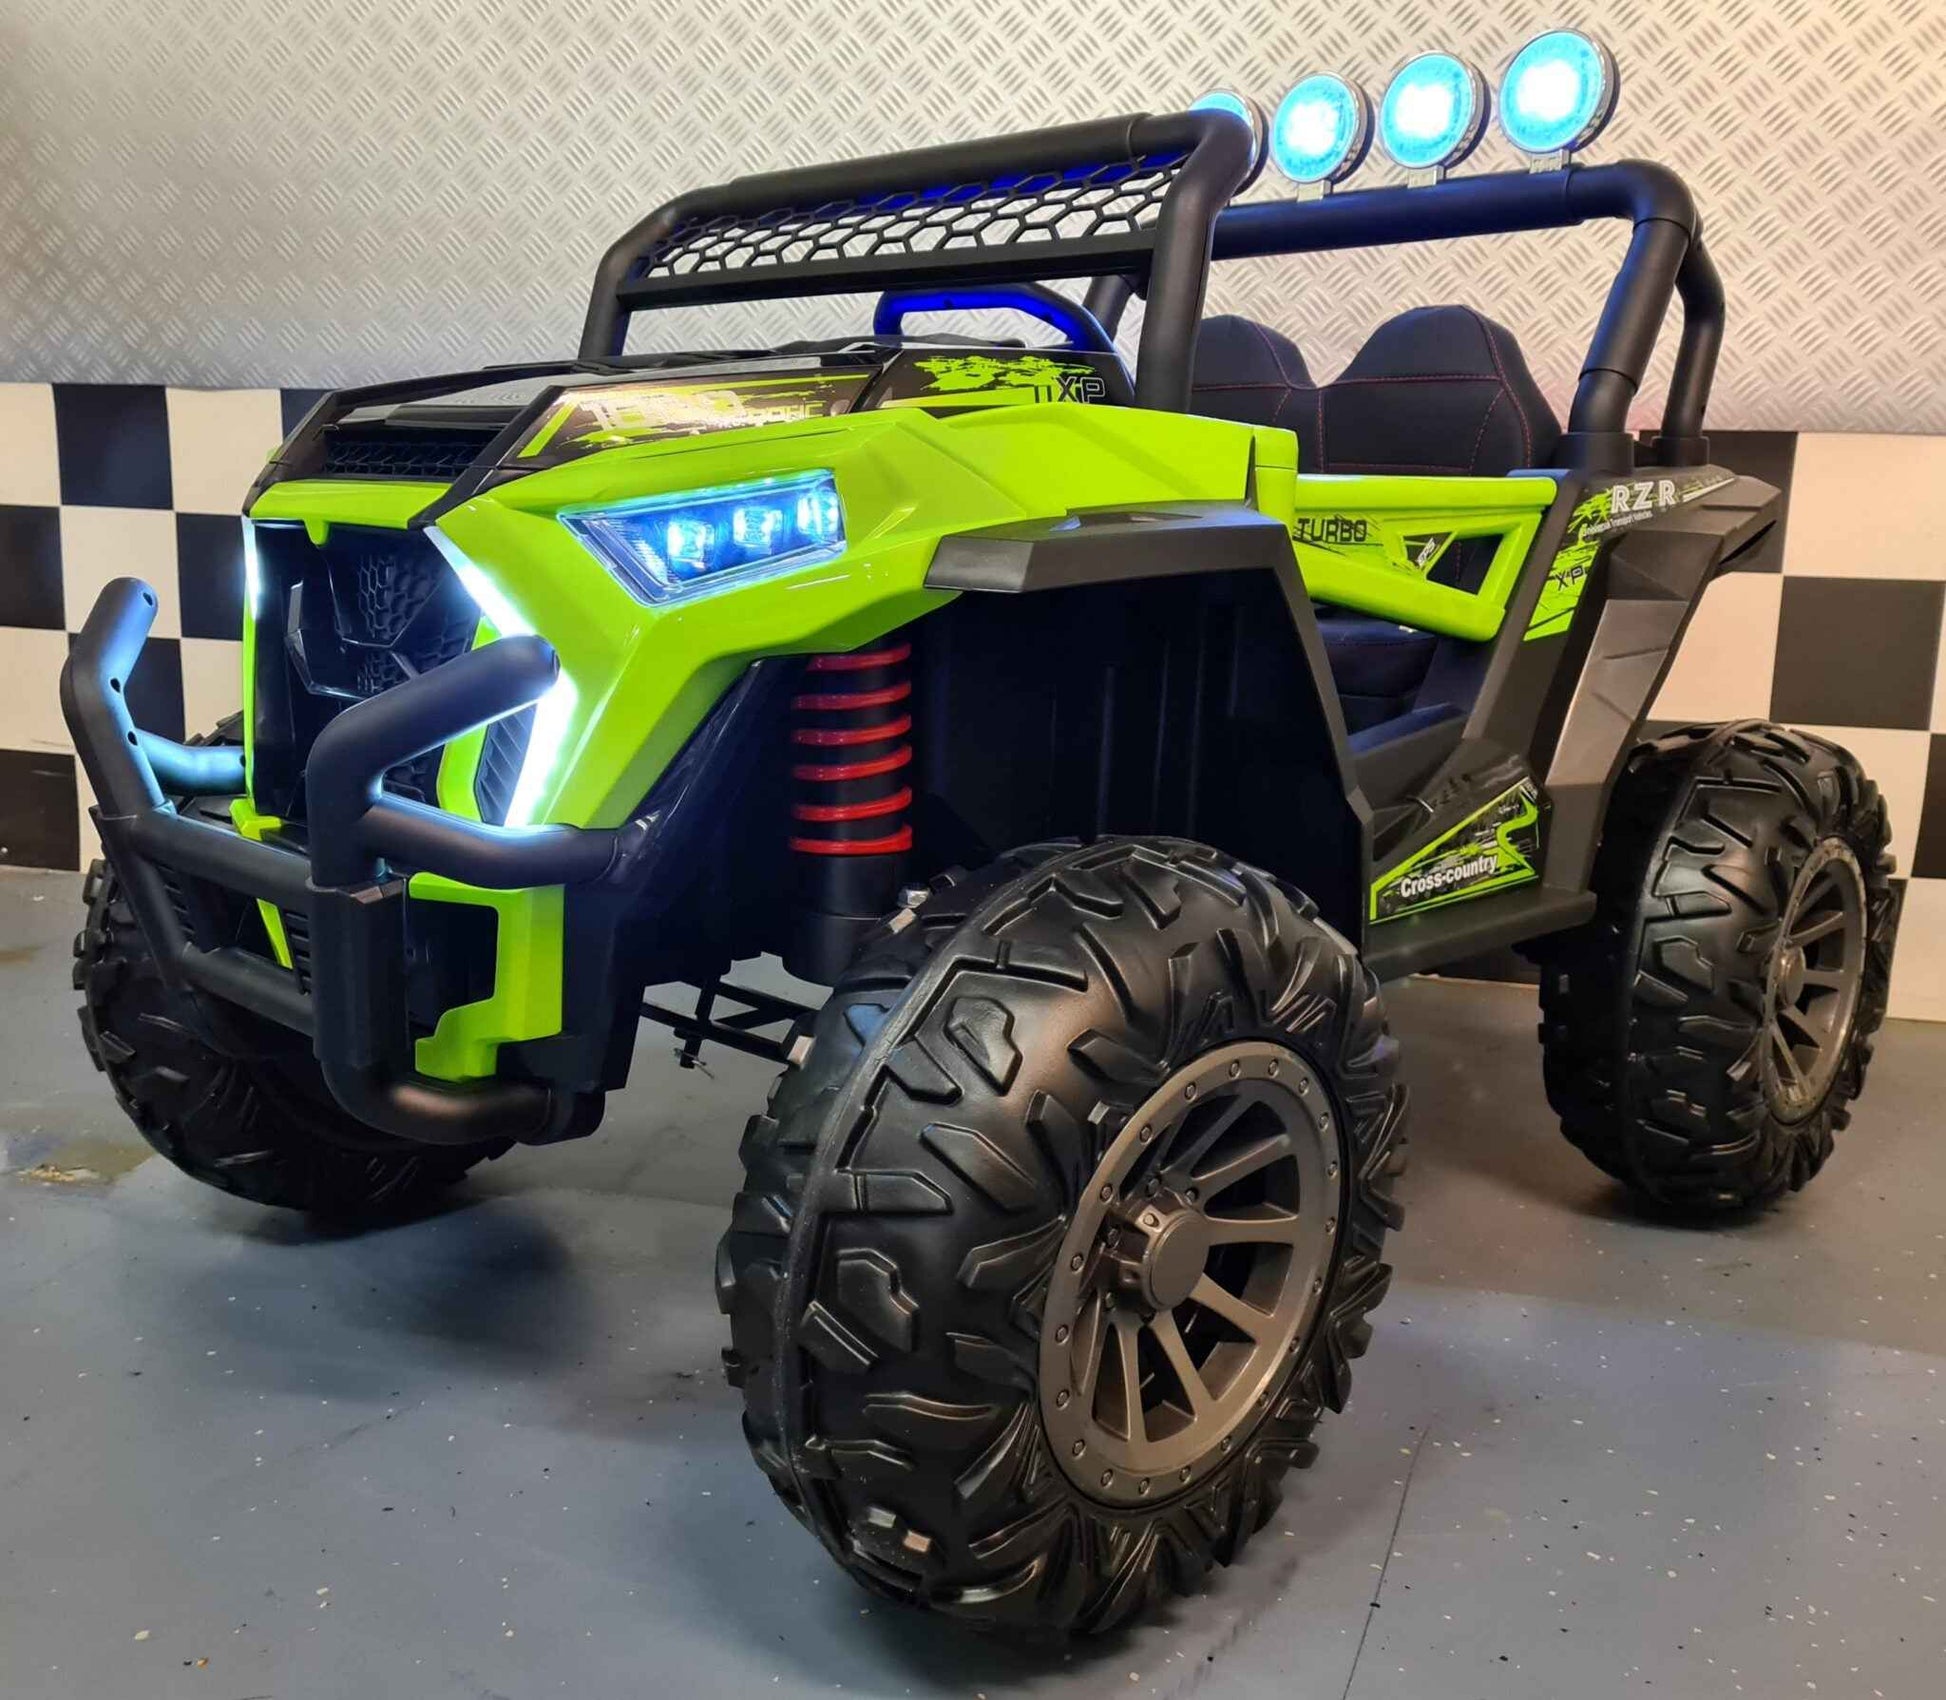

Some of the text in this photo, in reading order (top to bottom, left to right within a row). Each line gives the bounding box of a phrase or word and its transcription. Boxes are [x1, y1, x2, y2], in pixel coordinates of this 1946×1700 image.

[1611, 480, 1676, 514] RZR
[1297, 517, 1367, 543] TURBO
[1555, 565, 1584, 592] XP
[1400, 854, 1498, 898] Cross-country
